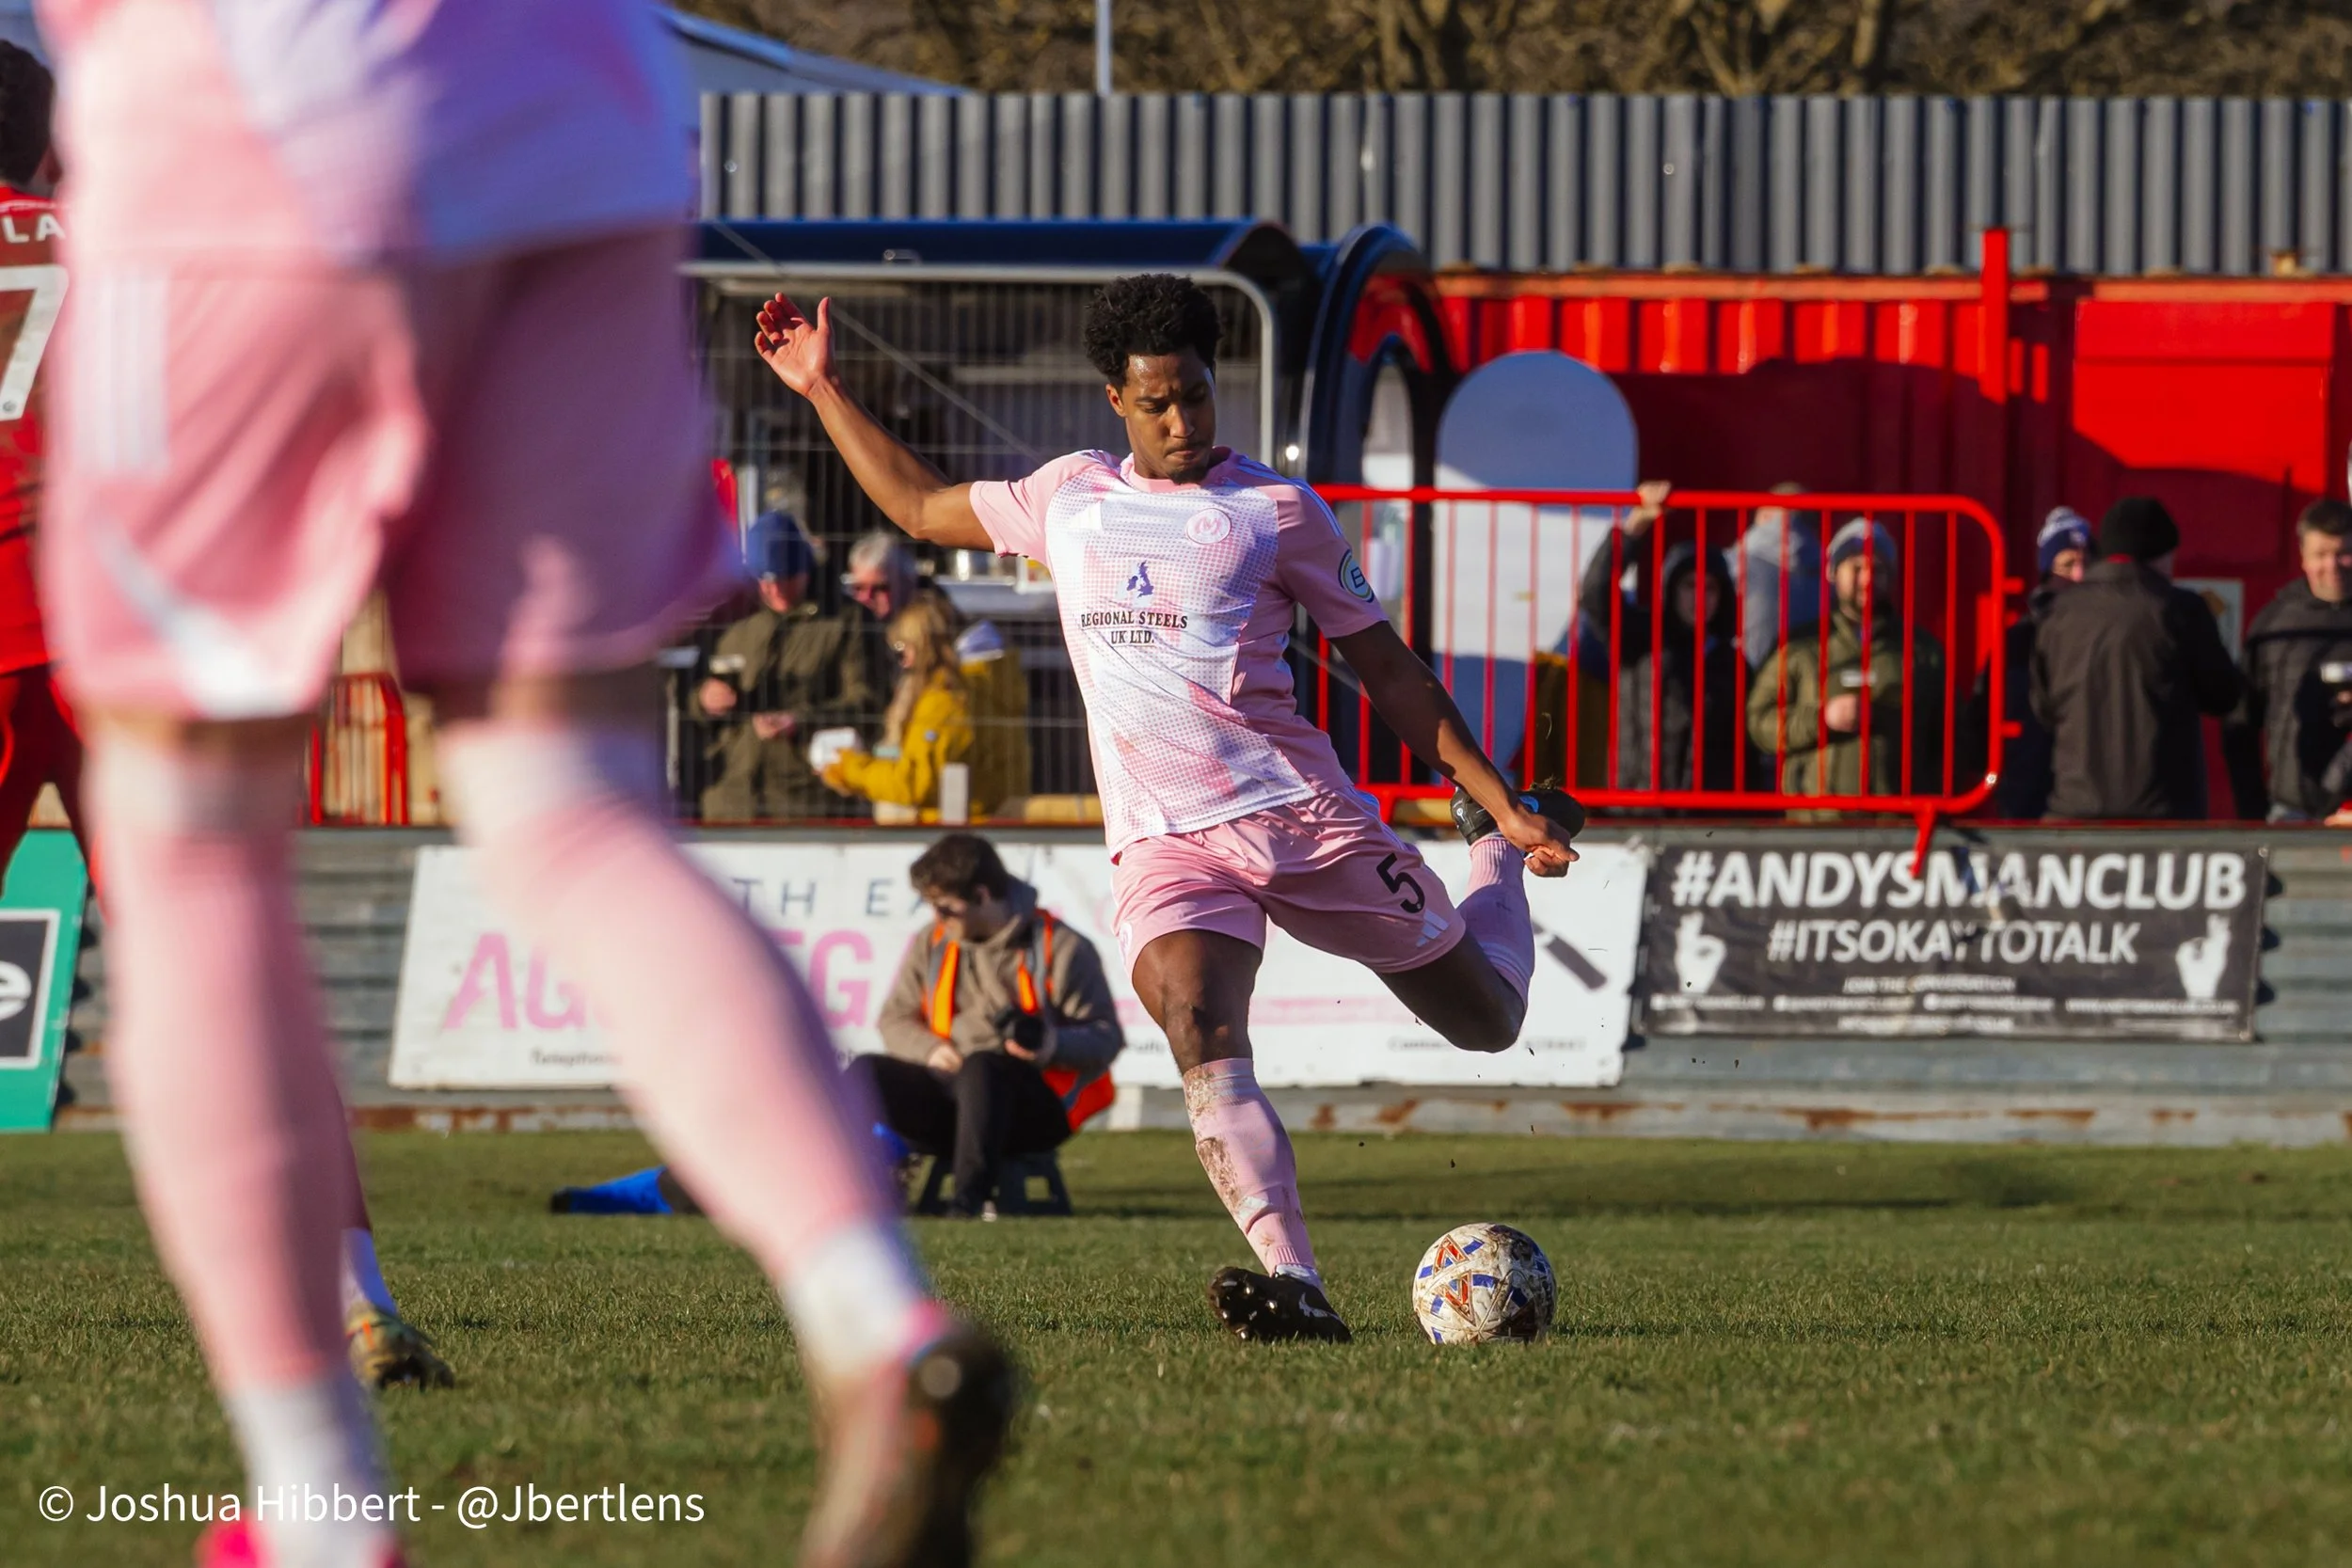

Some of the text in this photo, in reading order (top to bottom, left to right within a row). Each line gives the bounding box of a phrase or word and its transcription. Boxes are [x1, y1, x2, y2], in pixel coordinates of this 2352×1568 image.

[1080, 610, 1187, 629] REGIONAL STEELS
[1110, 630, 1154, 644] UK LTD.
[1375, 852, 1426, 914] 5
